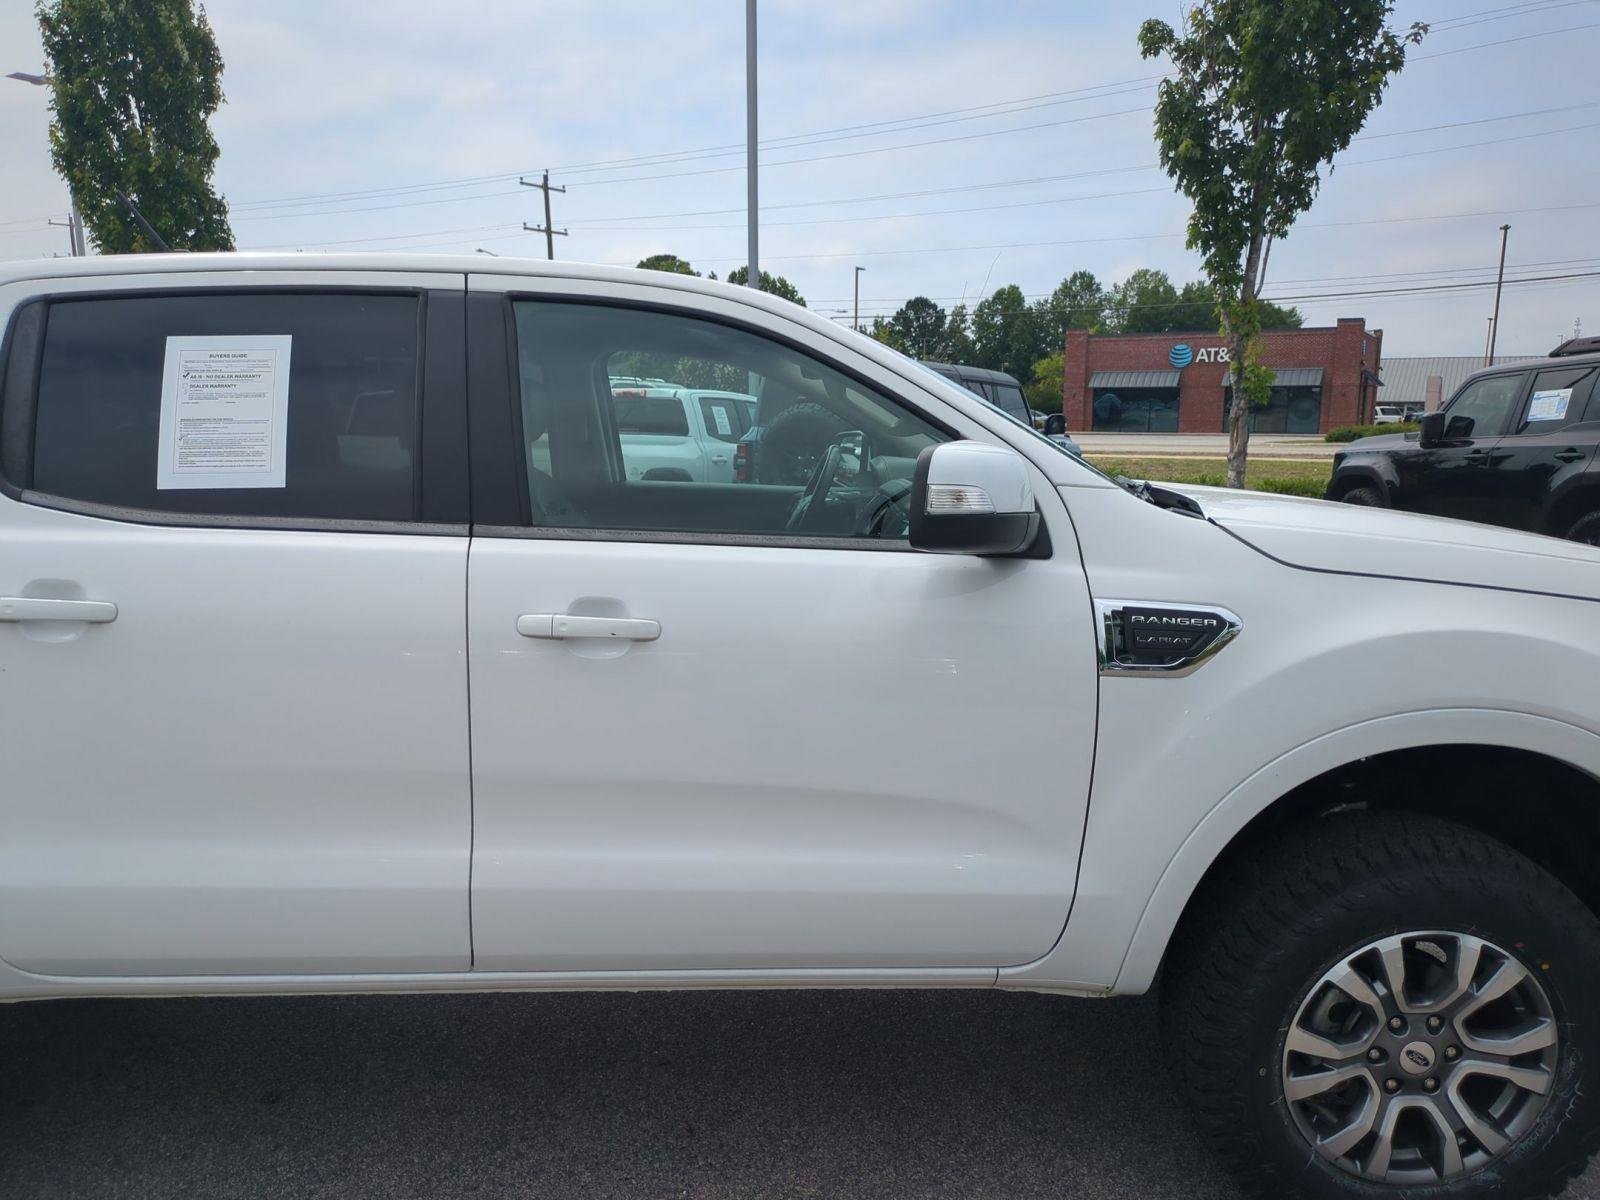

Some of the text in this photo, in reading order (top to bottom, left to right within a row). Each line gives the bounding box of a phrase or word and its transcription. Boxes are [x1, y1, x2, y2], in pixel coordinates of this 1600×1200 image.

[1195, 347, 1236, 363] AT&
[1131, 615, 1217, 627] RANGER
[1136, 636, 1192, 644] LARIAT
